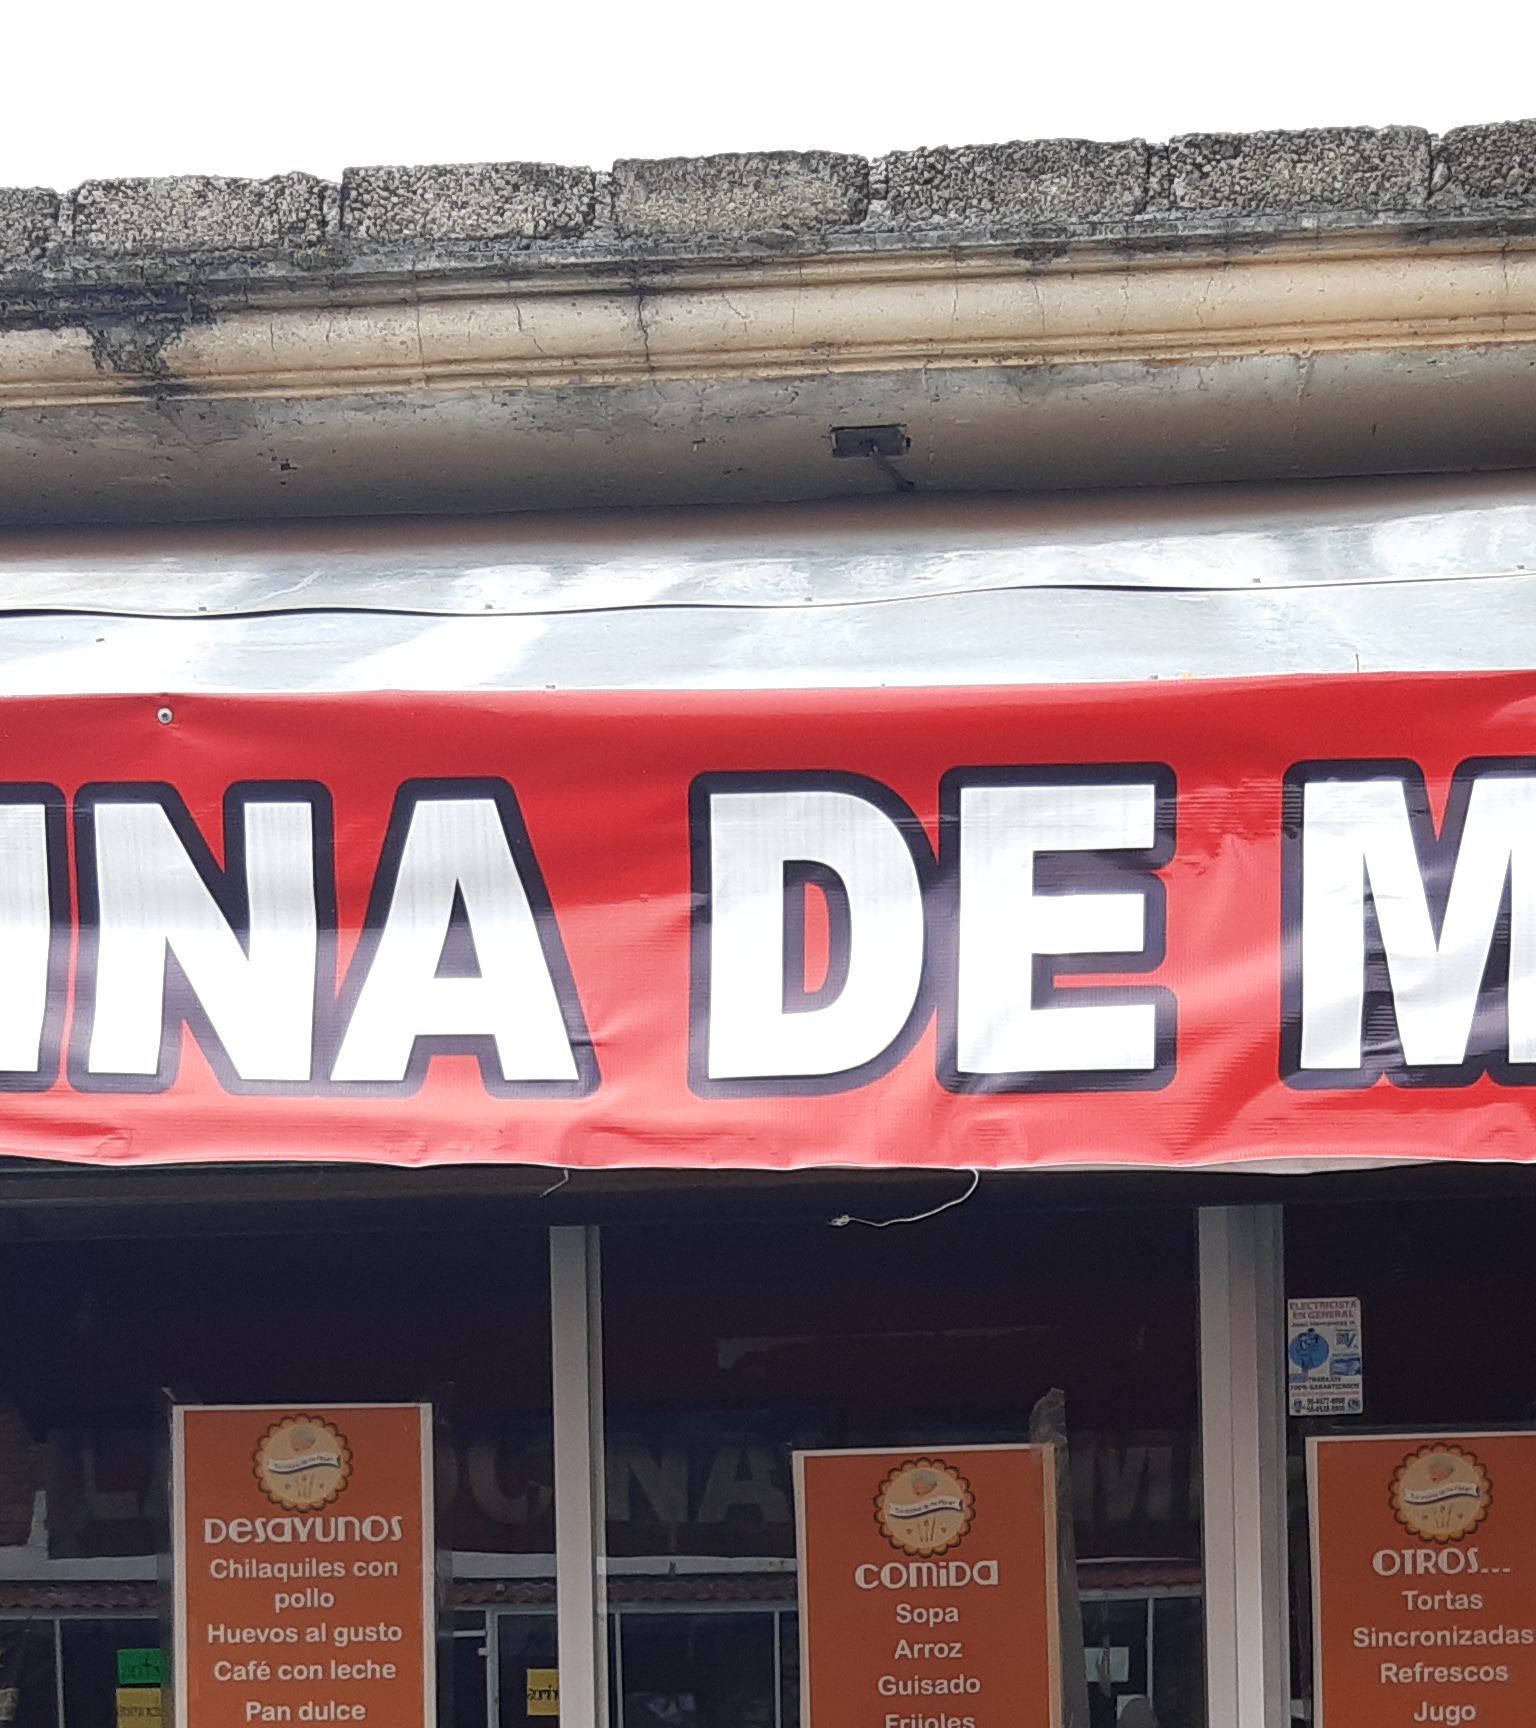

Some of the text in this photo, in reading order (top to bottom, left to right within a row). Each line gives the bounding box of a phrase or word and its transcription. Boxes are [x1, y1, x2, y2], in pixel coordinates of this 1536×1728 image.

[689, 761, 1176, 1098] DE
[210, 1557, 399, 1583] Chilaquiles con
[274, 1587, 336, 1614] pollo
[1401, 1589, 1484, 1611] Tortas
[895, 1603, 960, 1628] Sopa
[207, 1621, 403, 1648] Huevos al gusto
[1352, 1624, 1535, 1648] Sincronizadas
[894, 1638, 964, 1660] Arroz
[213, 1659, 397, 1682] Café con leche
[1379, 1661, 1510, 1684] Refrescos
[877, 1673, 982, 1697] Guisado
[245, 1700, 367, 1722] Pan dulce
[1413, 1701, 1477, 1727] Jugo
